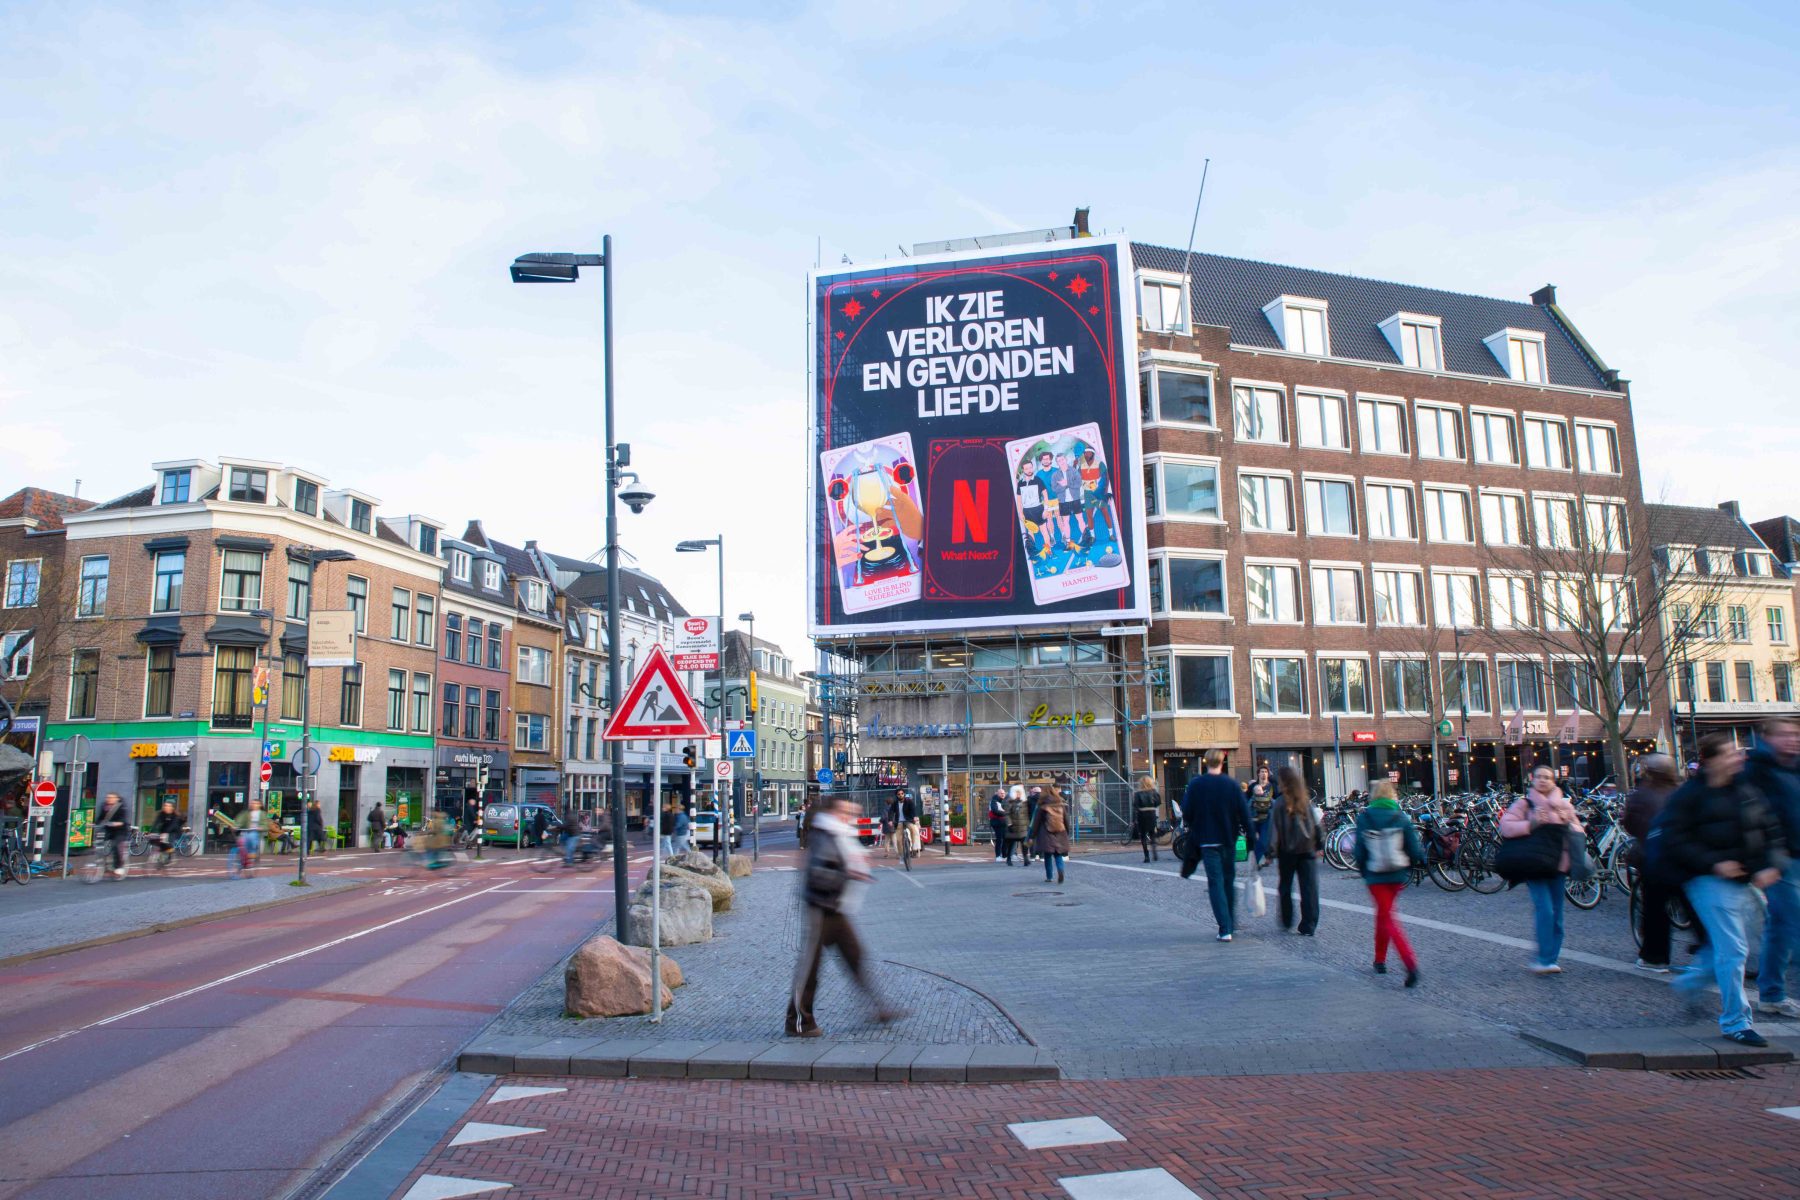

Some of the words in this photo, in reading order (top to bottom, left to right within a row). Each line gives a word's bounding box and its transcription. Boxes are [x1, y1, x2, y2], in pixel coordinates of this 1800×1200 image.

[926, 295, 956, 324] IK
[958, 290, 1004, 321] ZIE
[887, 316, 1045, 358] VERLOREN
[863, 361, 902, 391] EN
[906, 345, 1074, 387] GEVONDEN
[917, 381, 1020, 418] LIEFDE
[951, 479, 990, 544] N
[941, 550, 966, 561] What
[967, 550, 999, 561] Next?
[864, 589, 883, 597] LOVE
[890, 580, 912, 591] BLIND
[130, 741, 194, 758] SUBWAY
[328, 747, 380, 762] SUBWAY
